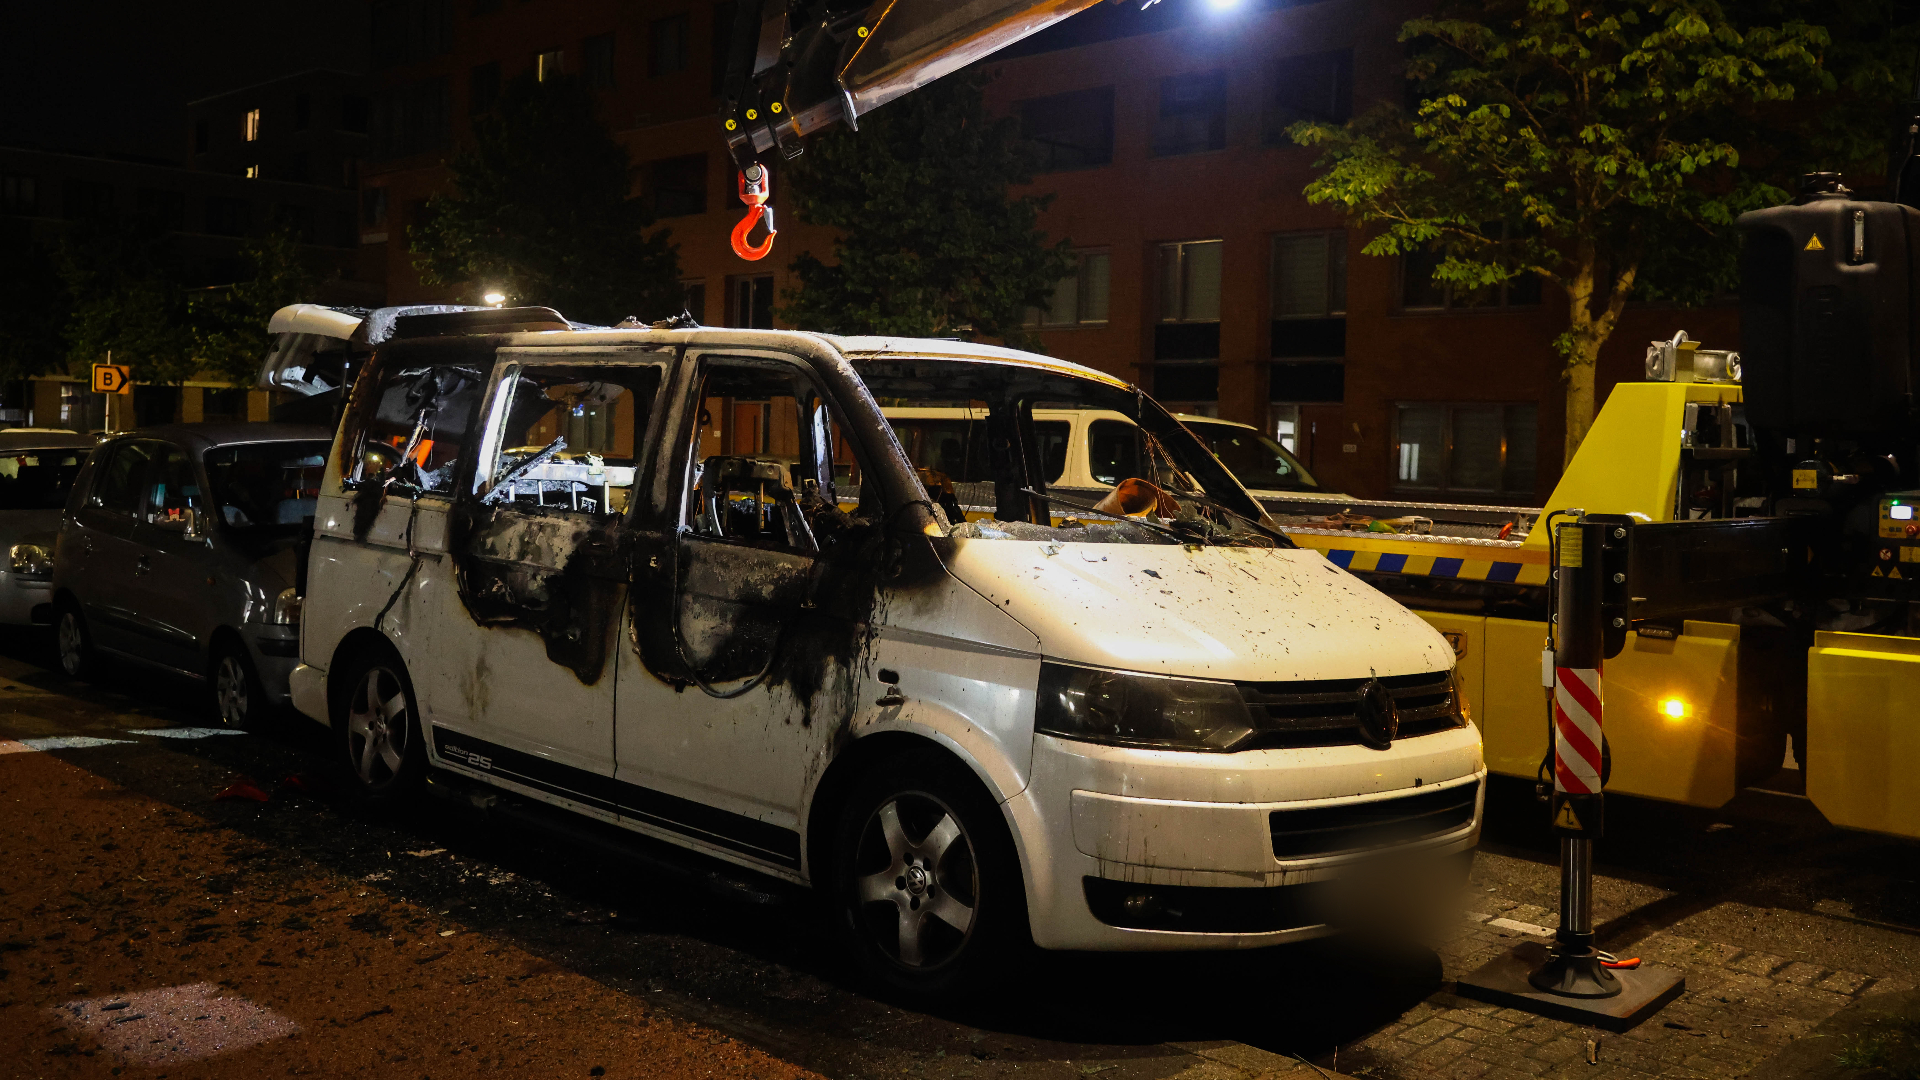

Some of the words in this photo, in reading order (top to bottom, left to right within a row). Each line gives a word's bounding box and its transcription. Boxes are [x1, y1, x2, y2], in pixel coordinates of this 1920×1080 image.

[104, 372, 113, 386] B
[444, 744, 469, 756] edition
[468, 752, 492, 770] 25
